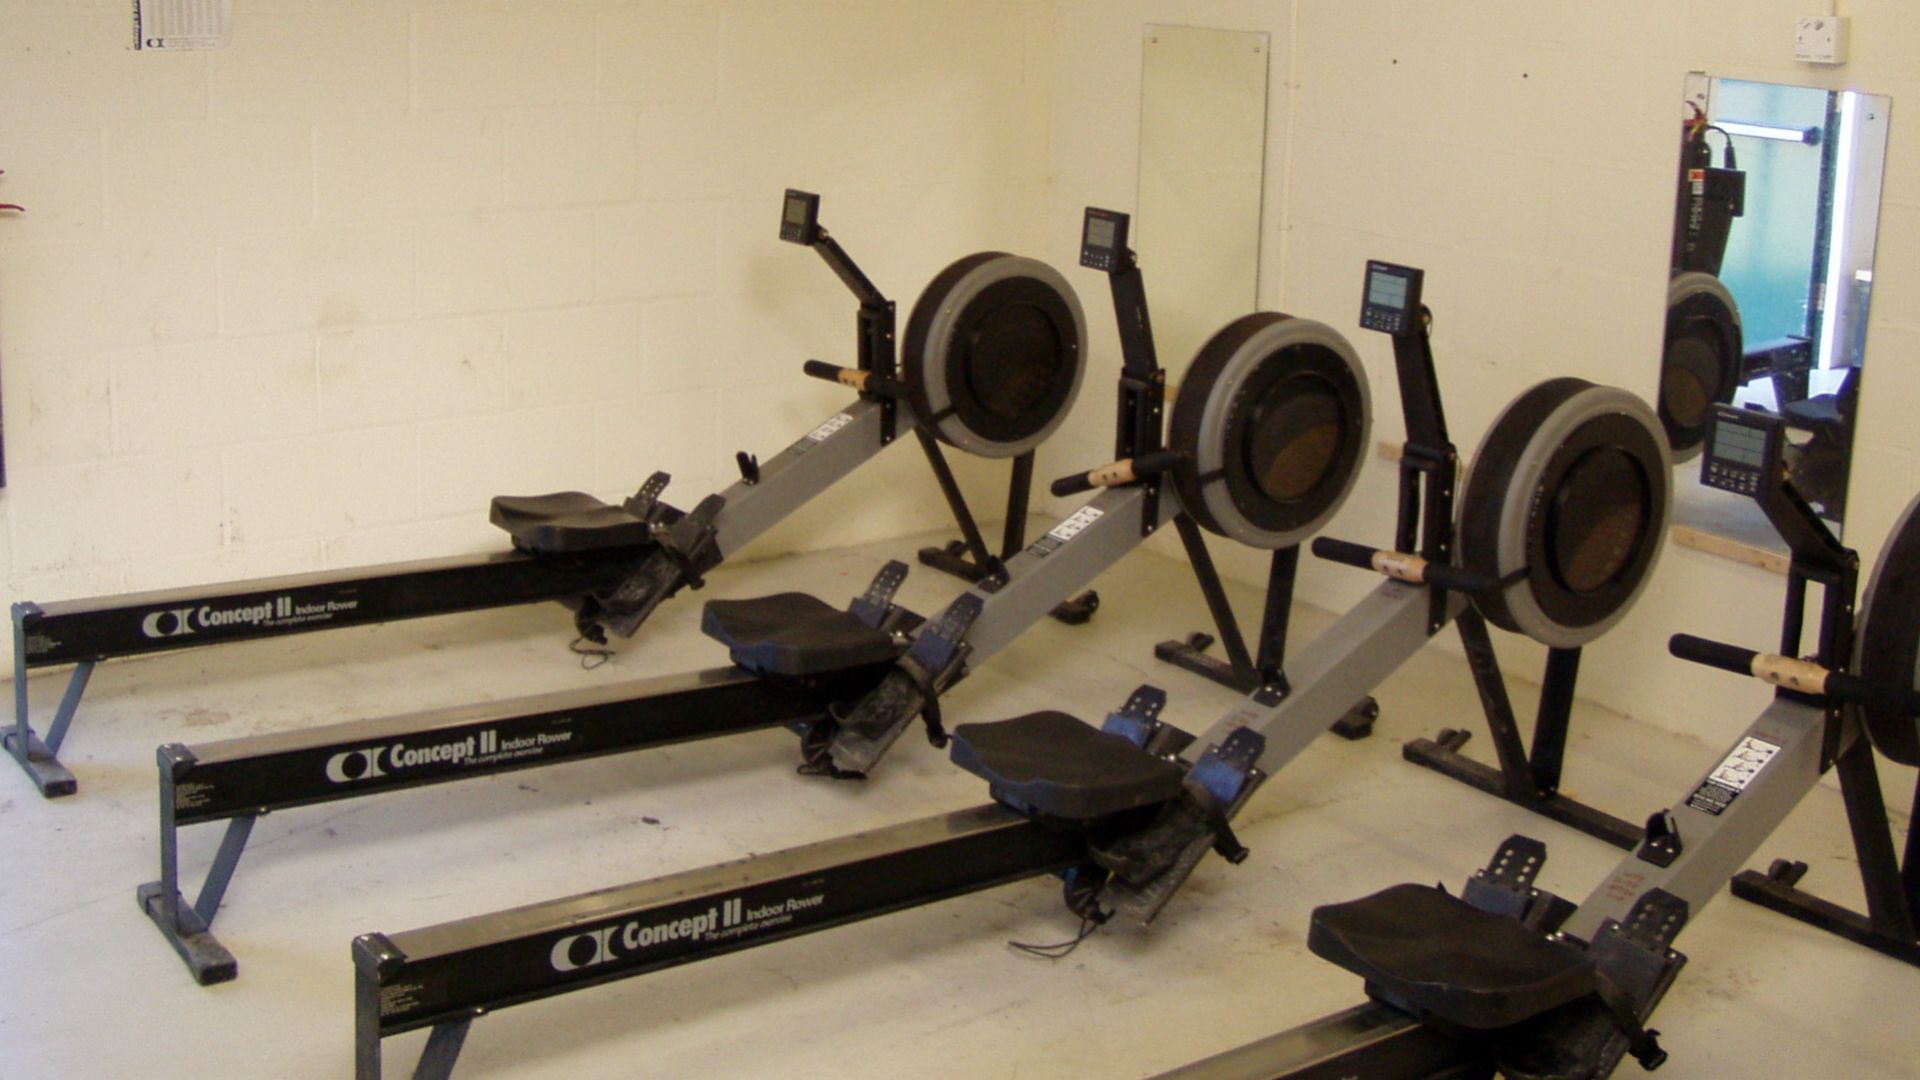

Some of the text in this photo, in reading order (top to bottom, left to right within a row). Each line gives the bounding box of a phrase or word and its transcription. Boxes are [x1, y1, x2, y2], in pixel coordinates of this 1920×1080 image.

[198, 602, 273, 627] Concept
[295, 603, 326, 615] Indoor
[390, 736, 475, 768] Concept
[501, 731, 573, 751] Indoor Rower
[747, 894, 825, 921] Indoor Rower
[623, 907, 718, 949] Concept
